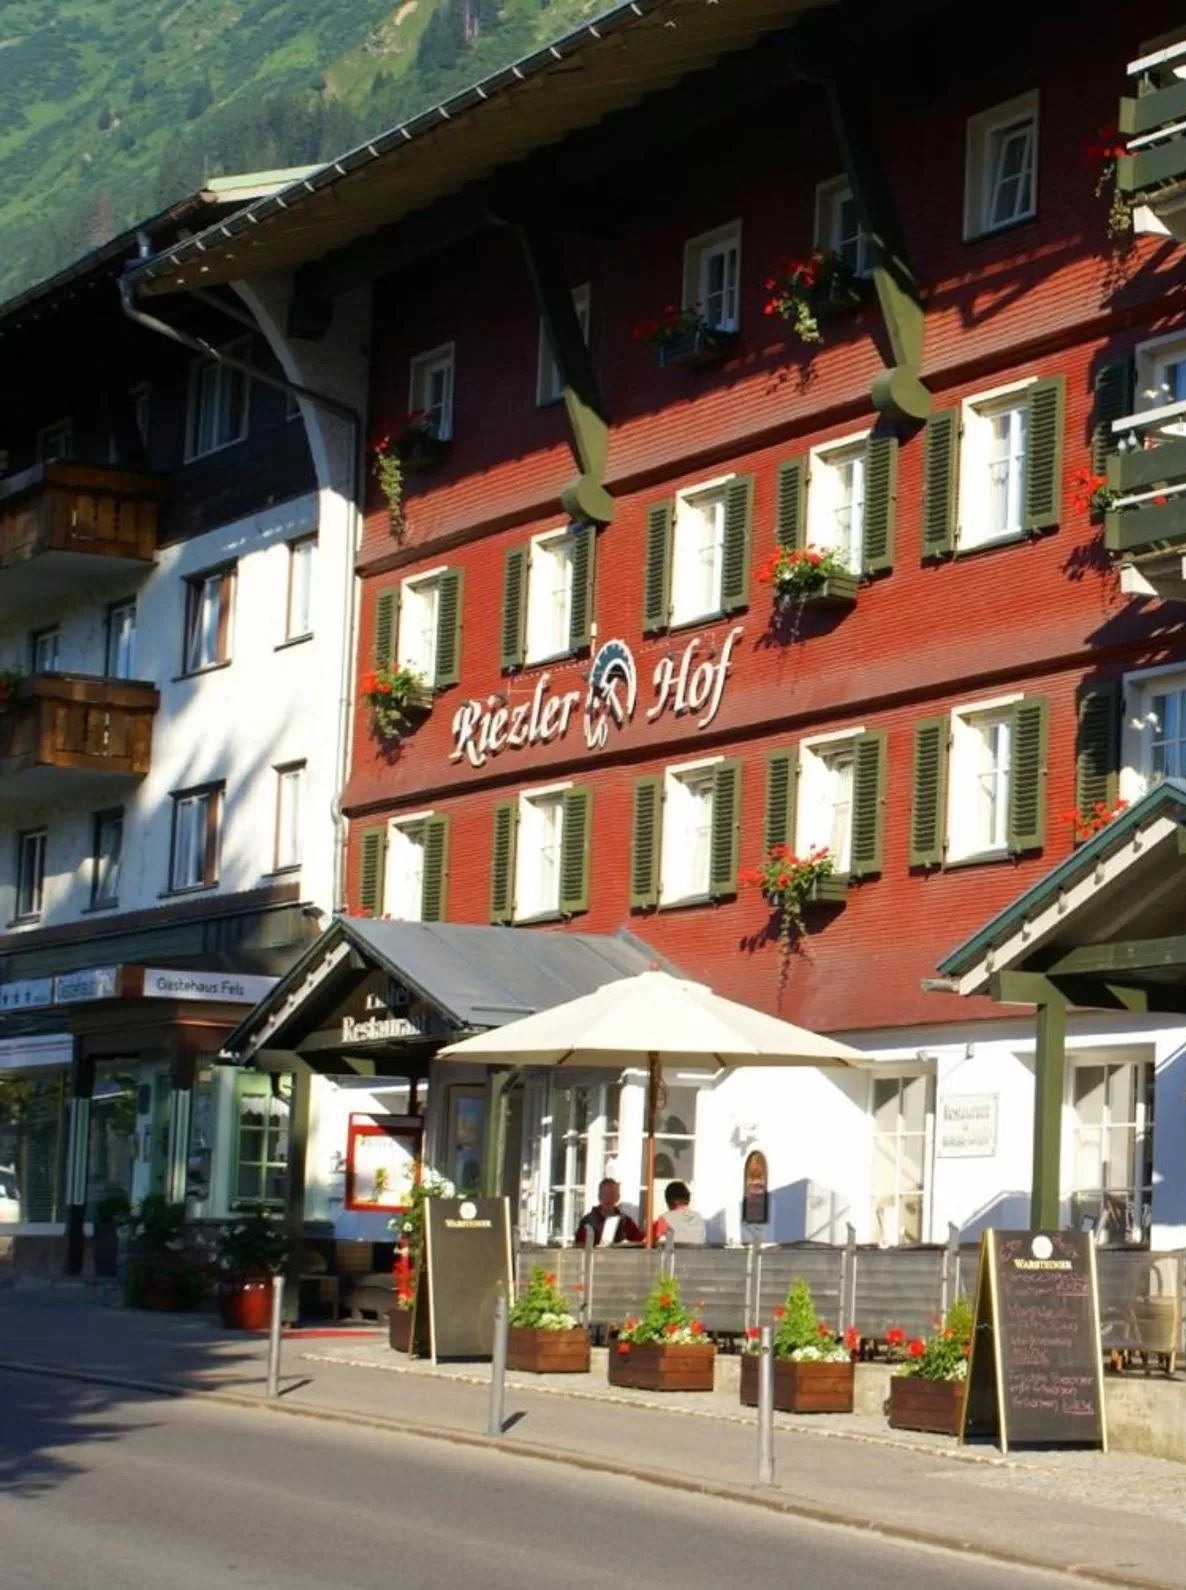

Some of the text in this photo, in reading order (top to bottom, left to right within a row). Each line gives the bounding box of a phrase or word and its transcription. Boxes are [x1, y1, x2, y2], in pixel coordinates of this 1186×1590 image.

[449, 626, 745, 767] Riezler Hof
[220, 980, 245, 996] Fels
[1013, 1258, 1073, 1271] WARSTEINER
